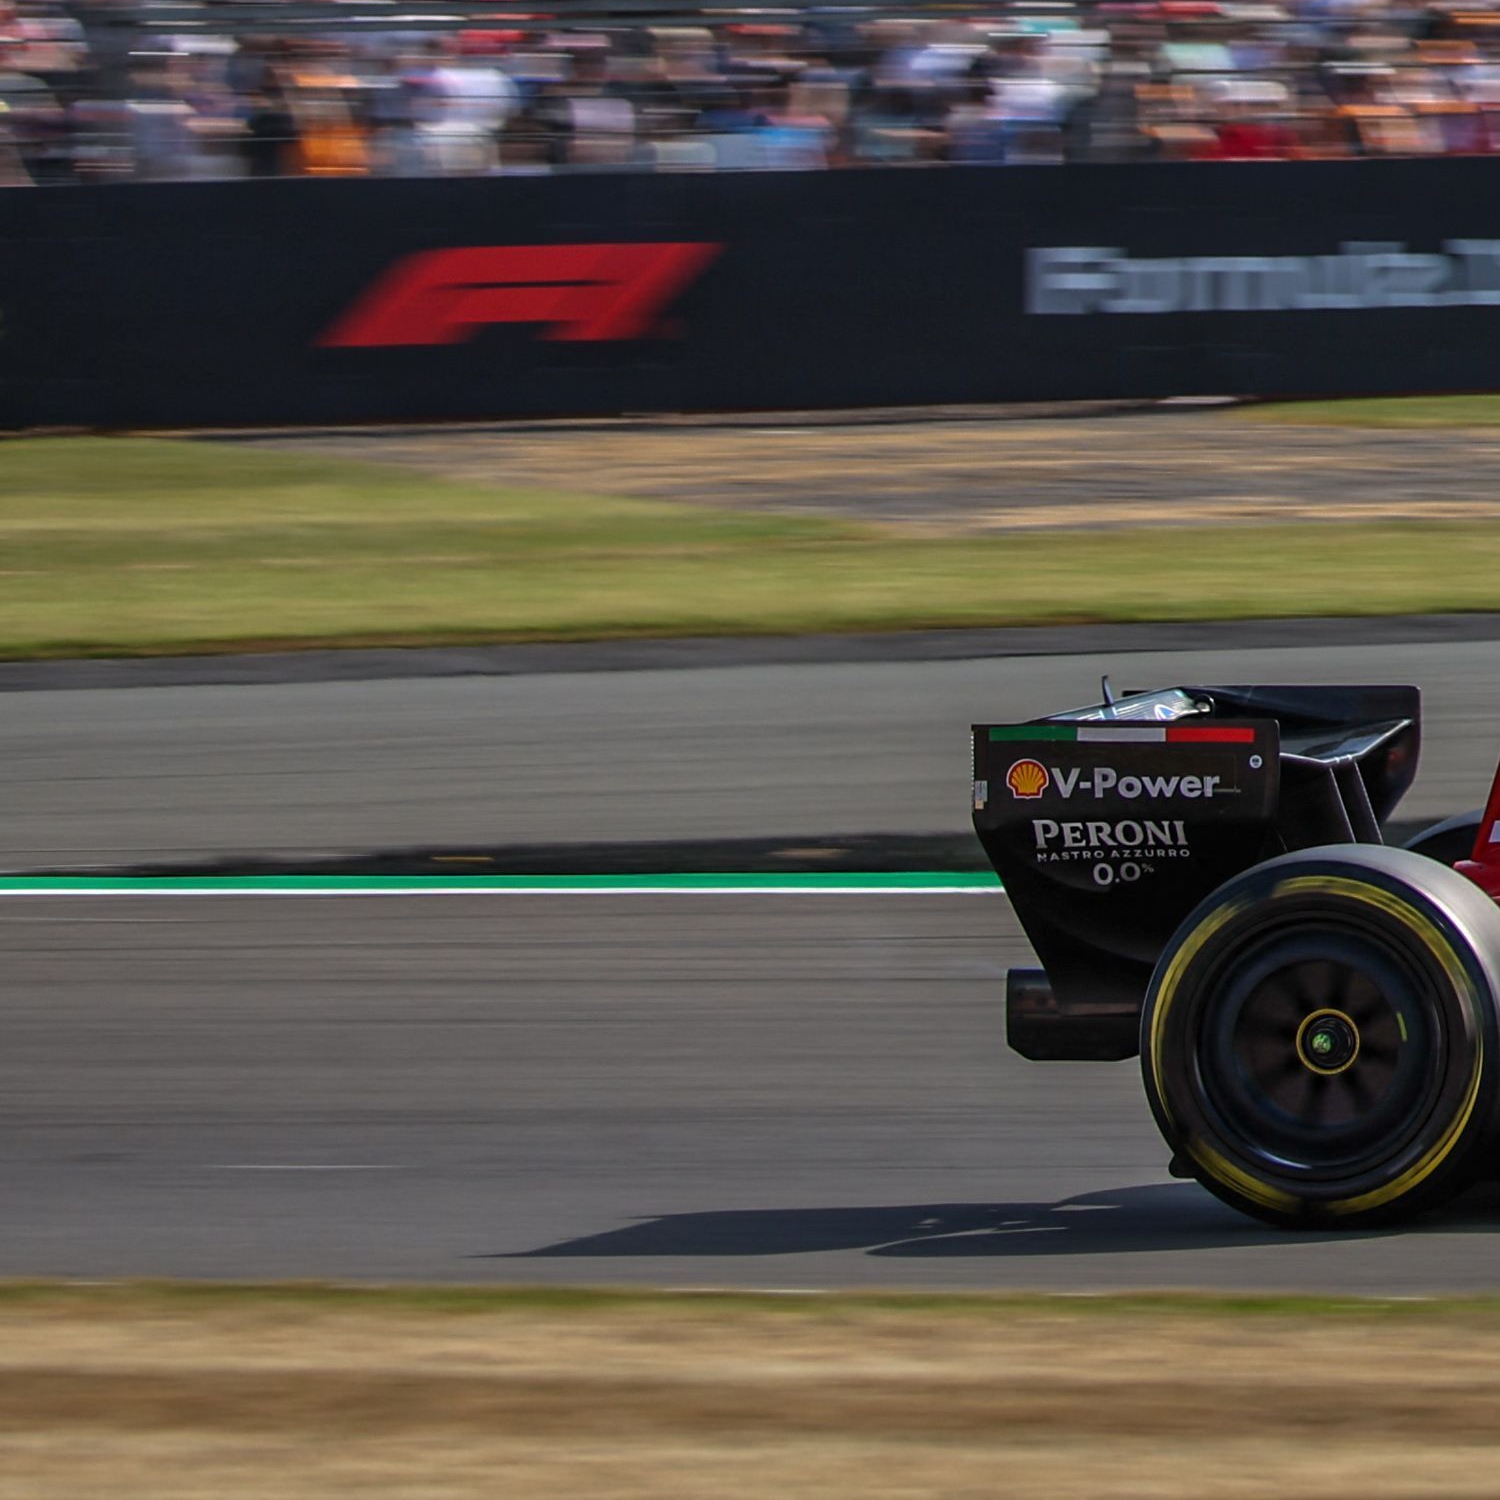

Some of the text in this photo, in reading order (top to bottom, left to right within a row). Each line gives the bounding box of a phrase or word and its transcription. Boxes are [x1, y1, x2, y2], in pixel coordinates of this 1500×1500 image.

[1050, 767, 1221, 799] V-Power
[1032, 819, 1189, 849] PERONI
[1037, 849, 1191, 862] NASTRO AZZURRO
